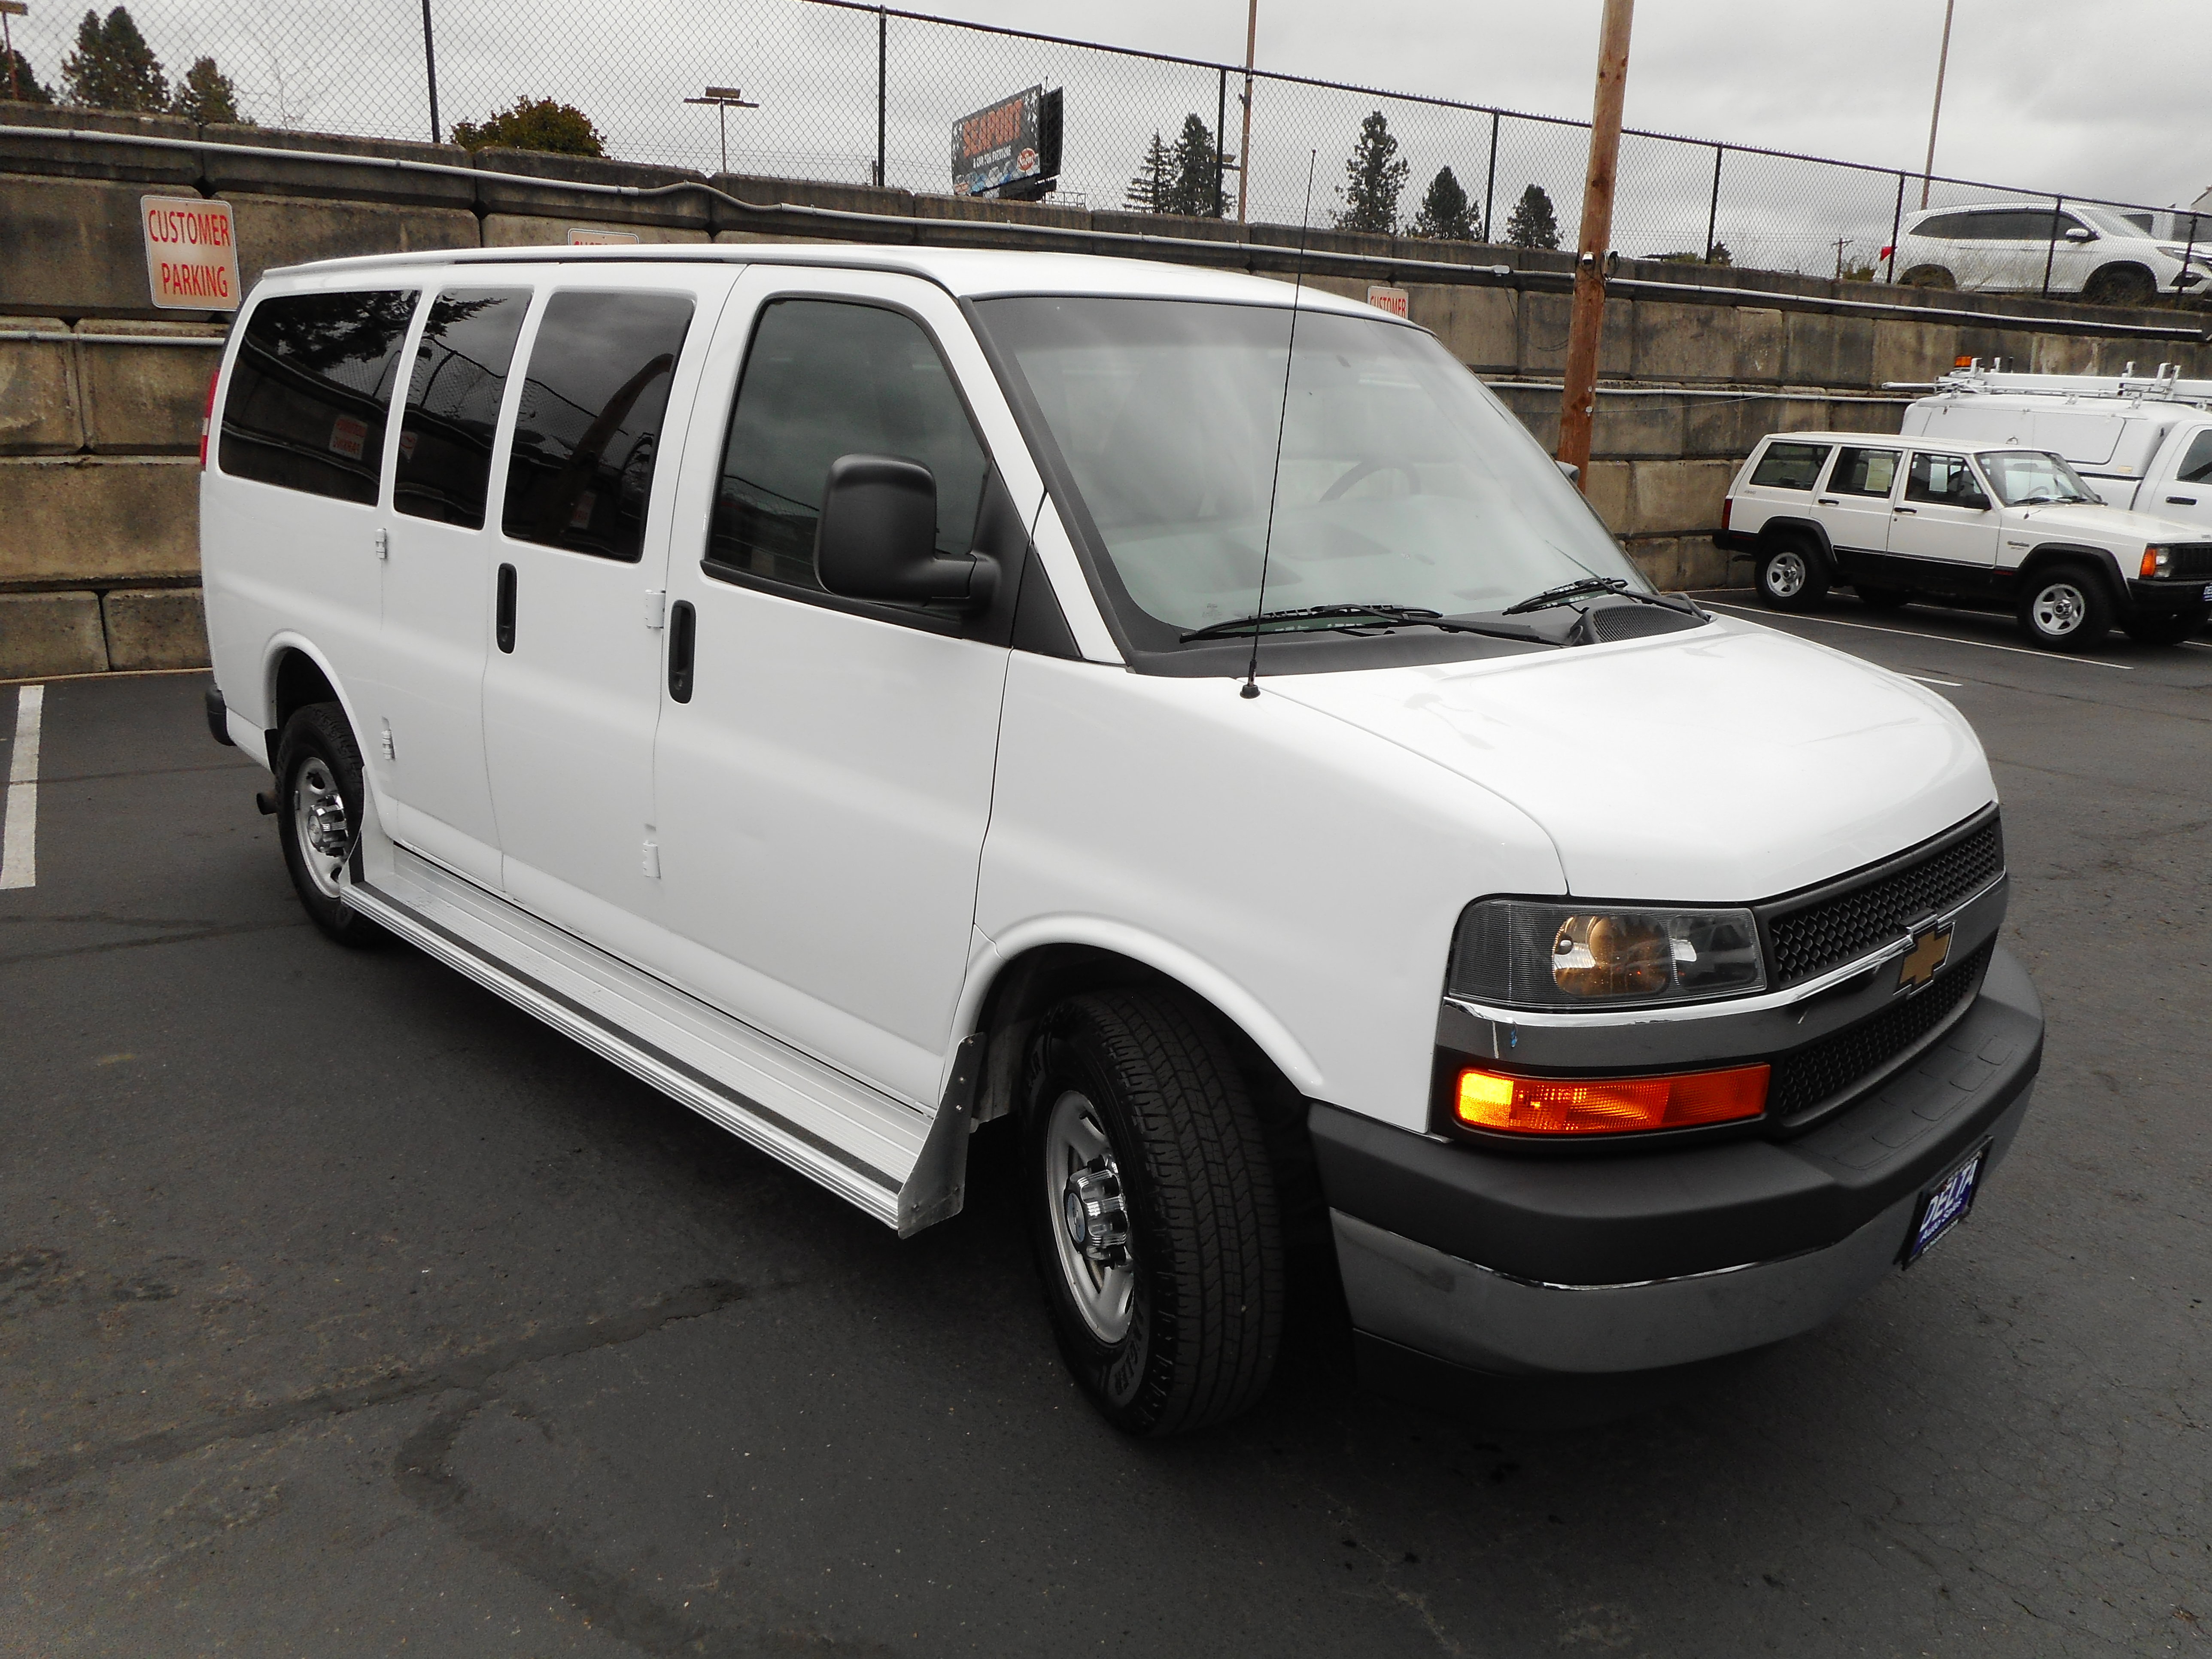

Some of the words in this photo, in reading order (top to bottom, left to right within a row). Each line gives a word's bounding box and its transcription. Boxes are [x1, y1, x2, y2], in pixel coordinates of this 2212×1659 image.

[149, 210, 231, 246] CUSTOMER
[161, 262, 228, 298] PARKING
[1920, 1159, 1978, 1232] DELTA
